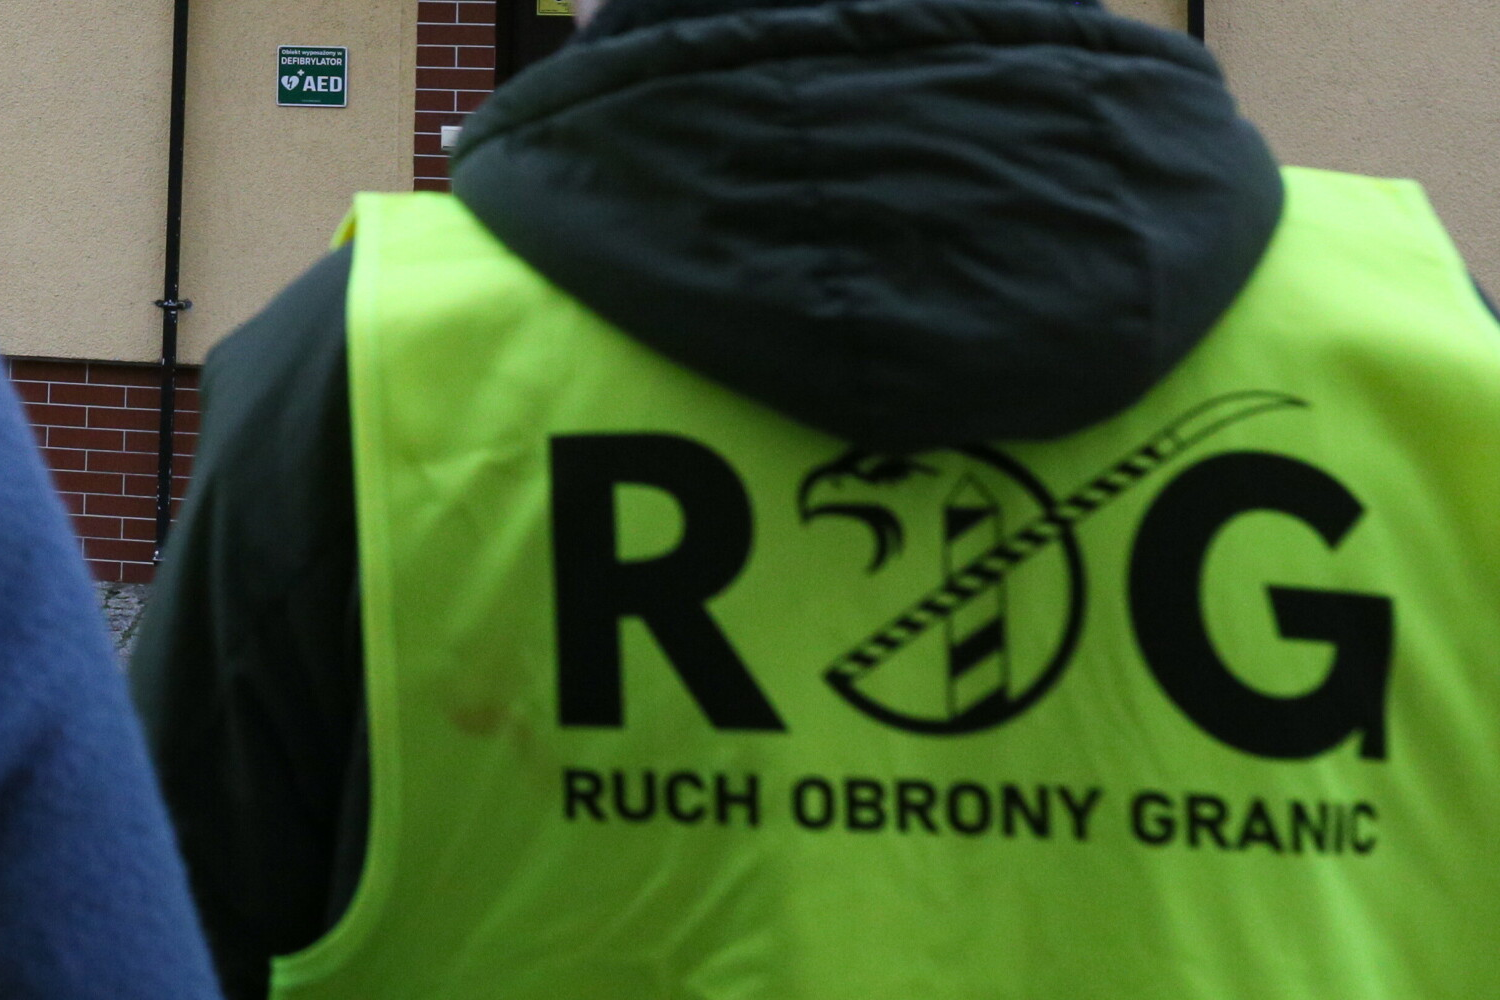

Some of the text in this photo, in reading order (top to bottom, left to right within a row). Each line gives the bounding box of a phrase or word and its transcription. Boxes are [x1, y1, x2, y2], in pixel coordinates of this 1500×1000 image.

[281, 57, 342, 65] DEFIBRYLATOR
[302, 76, 342, 92] AED
[562, 768, 1378, 854] RUCH OBRONY GRANIC
